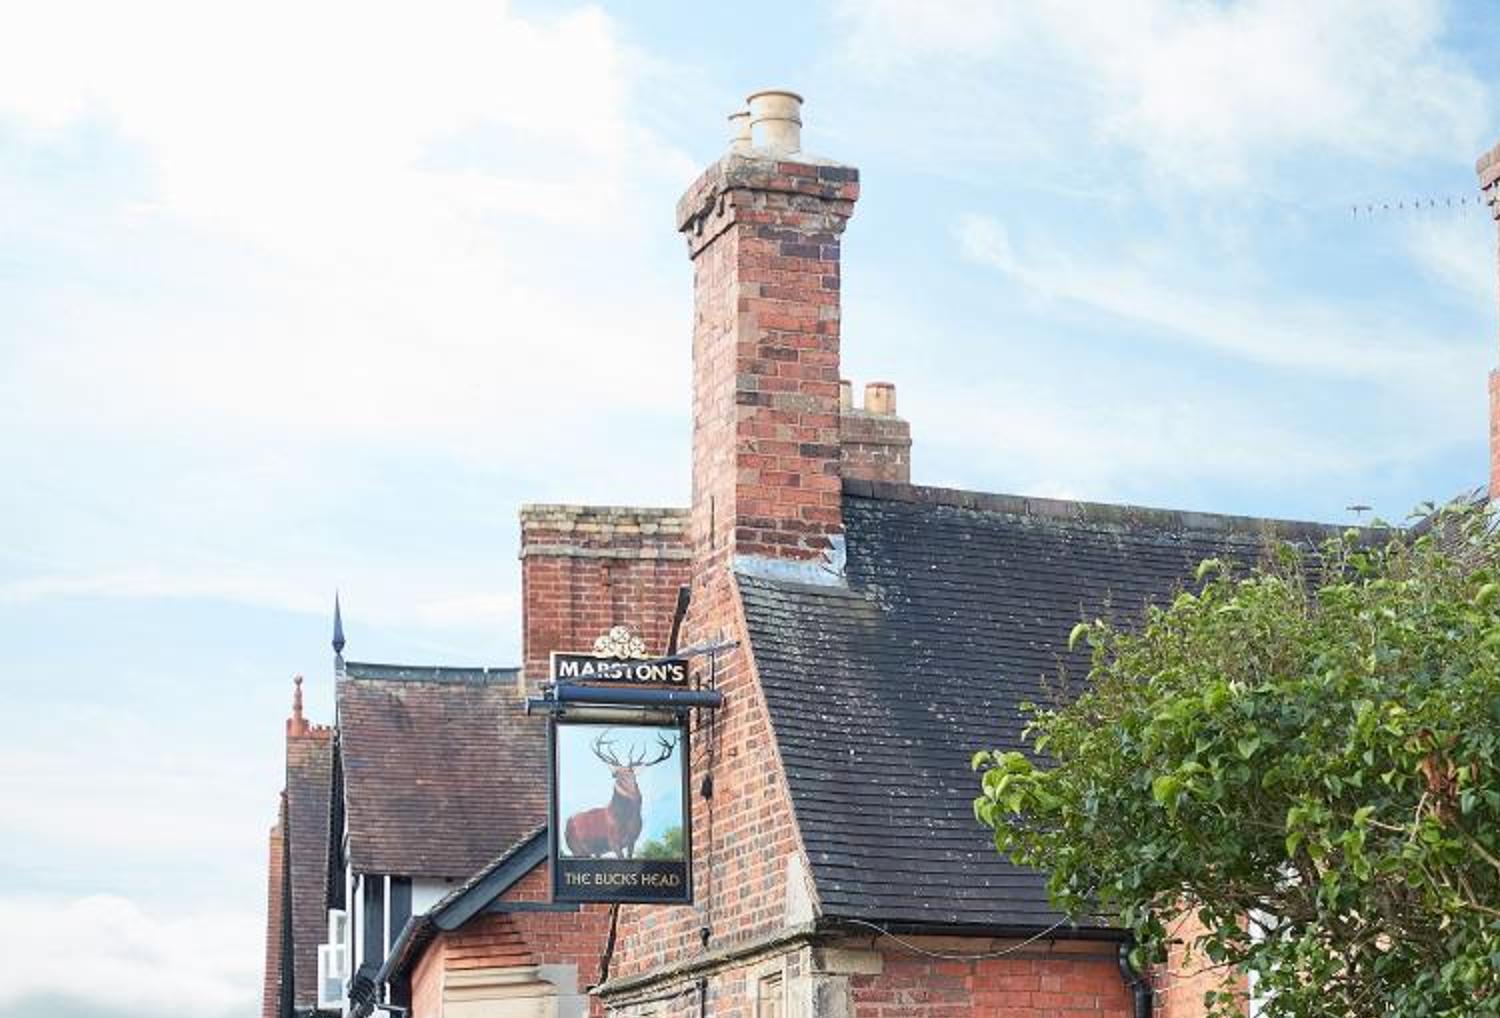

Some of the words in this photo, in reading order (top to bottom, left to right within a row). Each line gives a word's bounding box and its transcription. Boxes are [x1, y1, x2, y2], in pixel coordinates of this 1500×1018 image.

[559, 660, 685, 682] MARSTON'S
[564, 872, 591, 885] THE
[595, 872, 637, 886] BUCKS
[641, 873, 681, 887] HEAD
